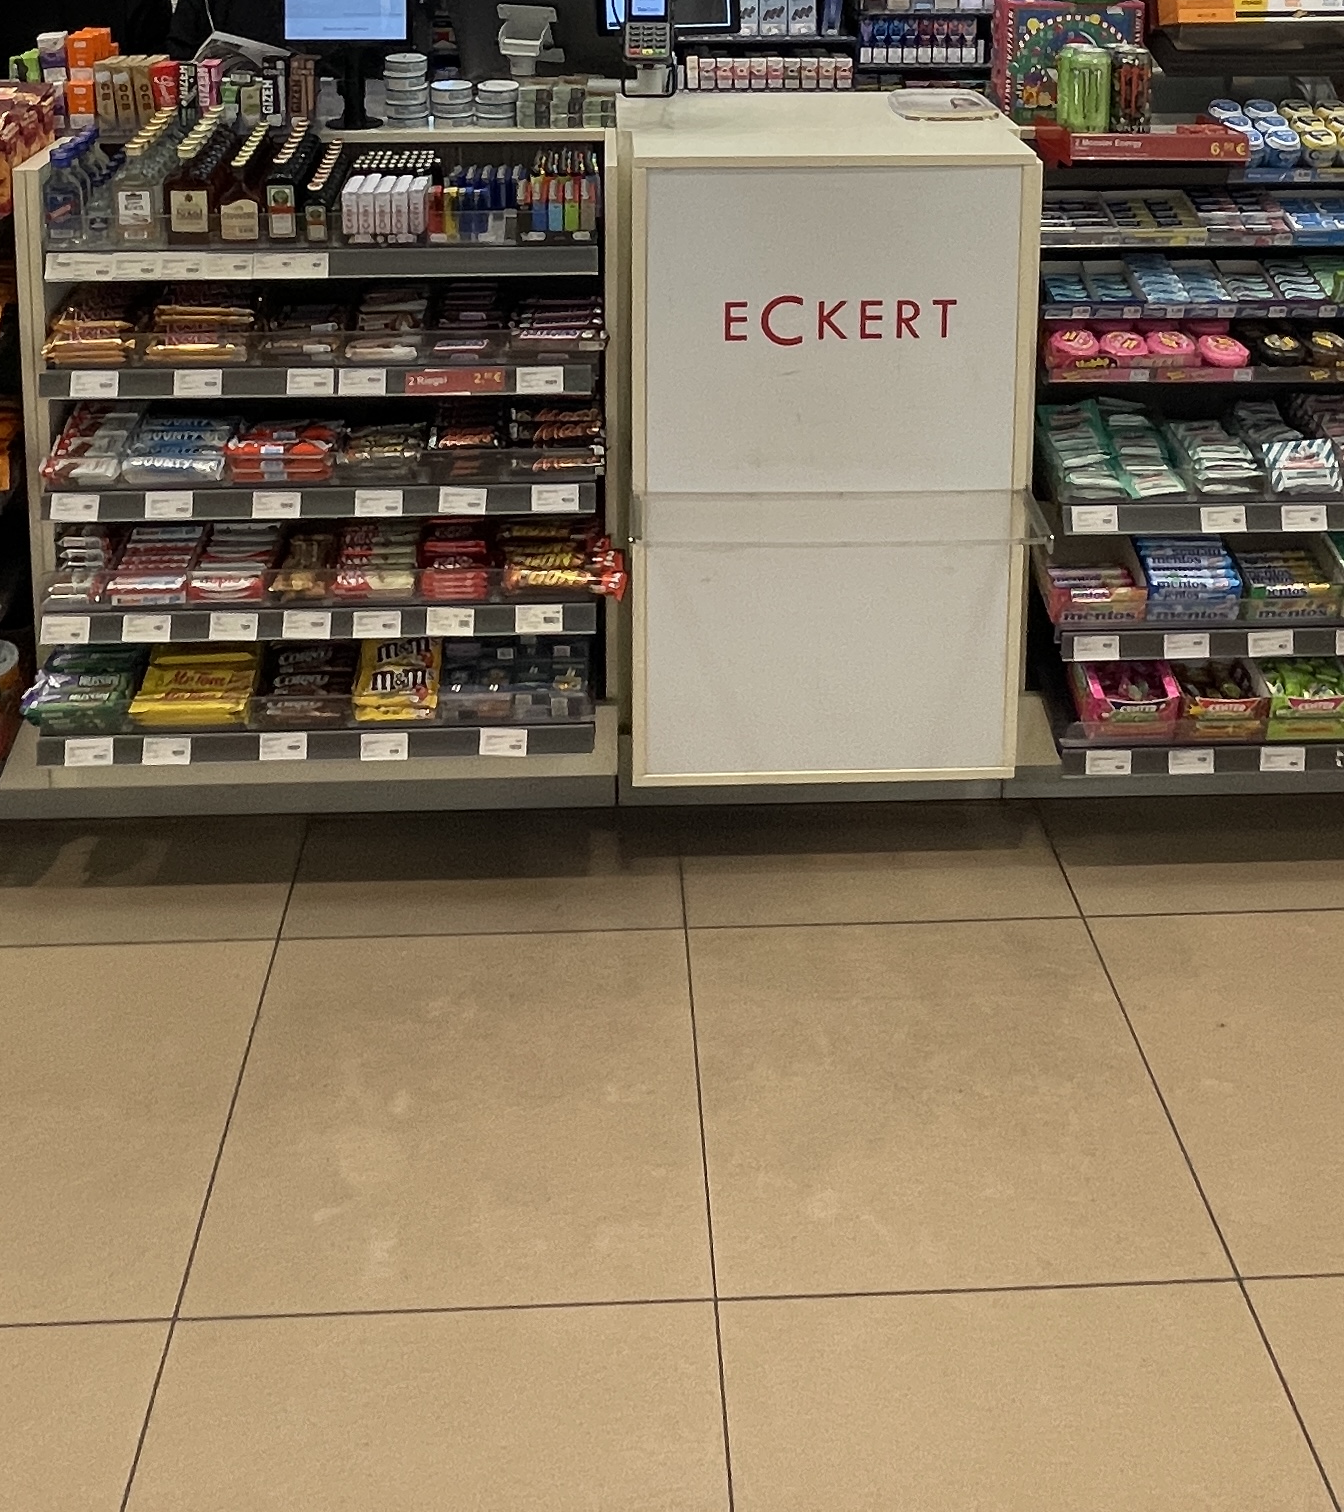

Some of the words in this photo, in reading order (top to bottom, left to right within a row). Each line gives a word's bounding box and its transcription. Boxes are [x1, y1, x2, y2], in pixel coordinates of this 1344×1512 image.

[262, 80, 274, 114] GIZEH
[1115, 139, 1142, 148] Energy
[722, 295, 958, 346] ECKERT
[408, 376, 414, 386] 2
[416, 375, 447, 388] Riegel
[1064, 610, 1136, 621] mentos
[1156, 610, 1230, 620] mentos
[1258, 608, 1328, 620] mentos
